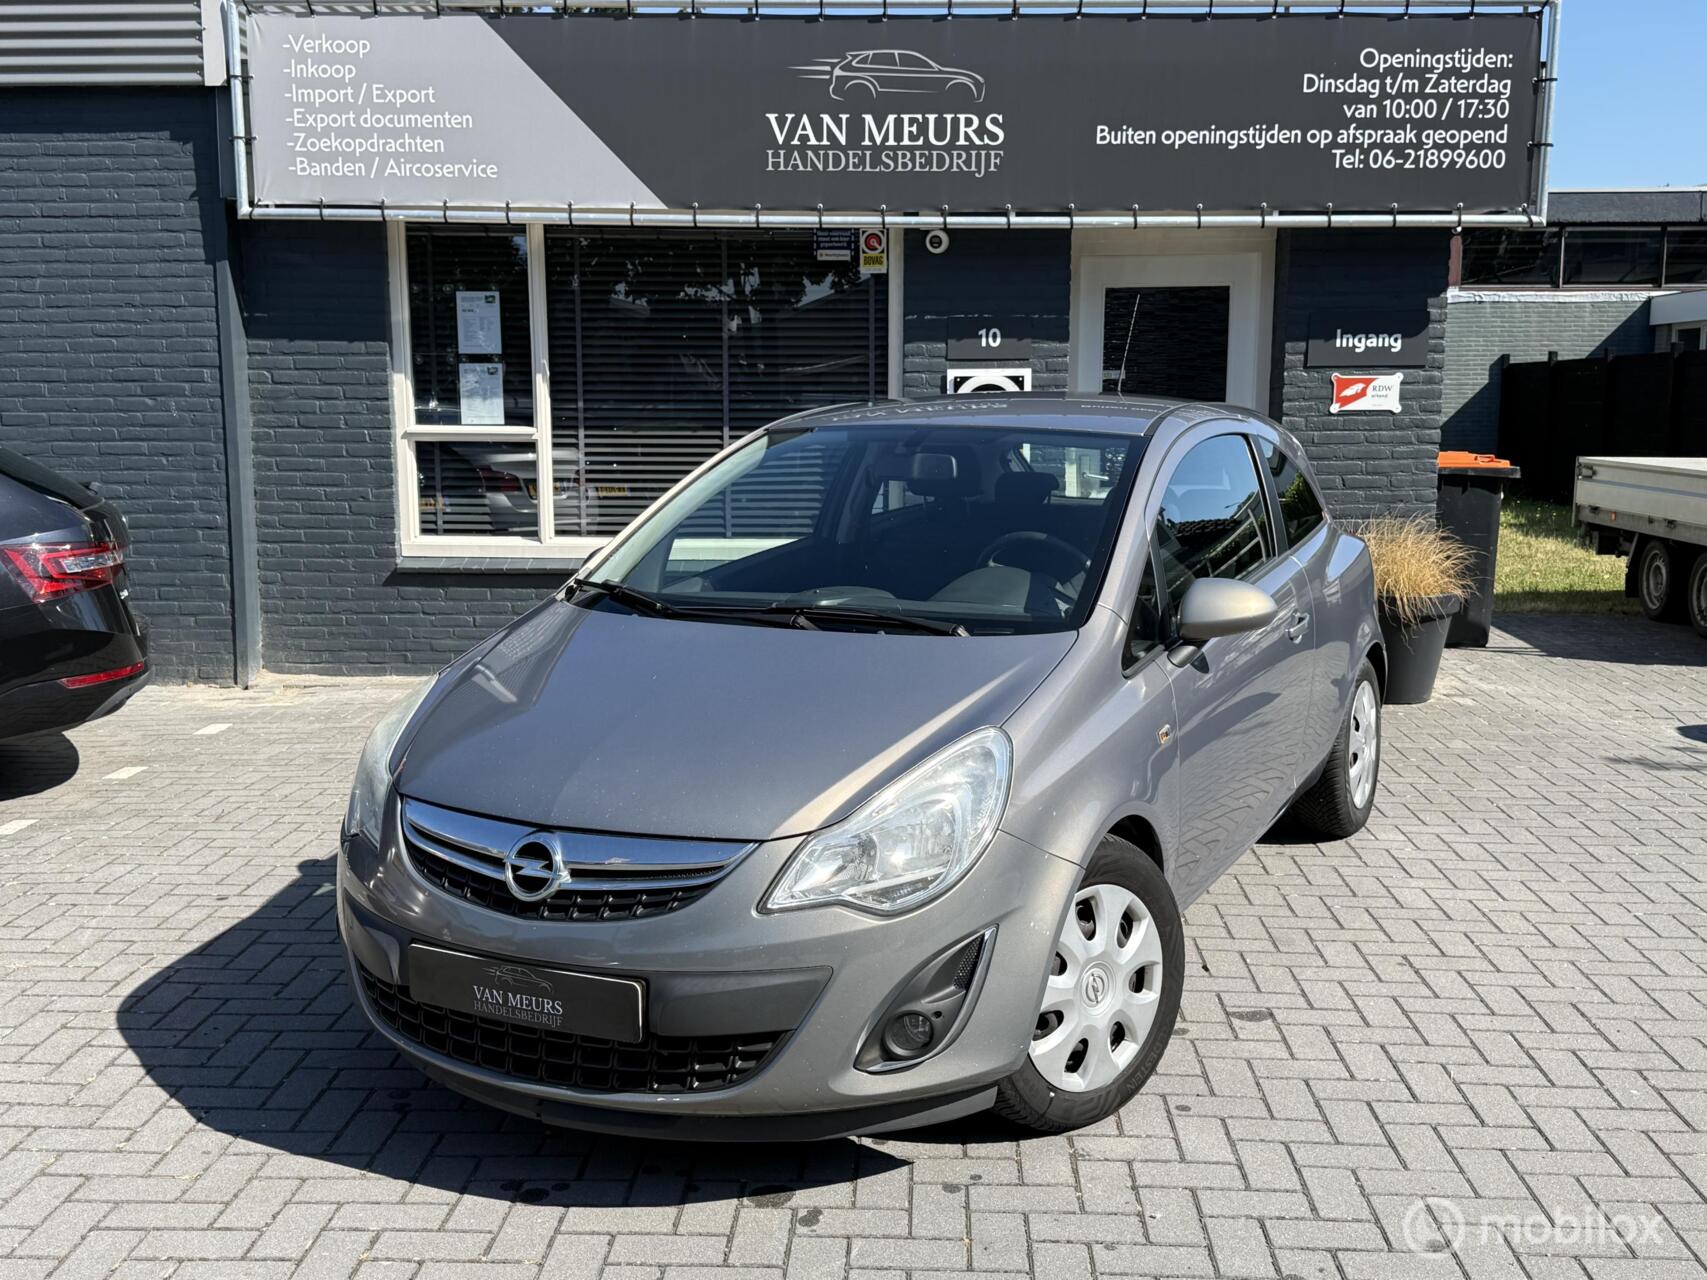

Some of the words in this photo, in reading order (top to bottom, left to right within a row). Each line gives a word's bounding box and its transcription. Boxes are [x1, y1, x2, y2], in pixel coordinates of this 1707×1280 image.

[282, 34, 371, 58] -Verkoop
[282, 58, 357, 82] -Inkoop
[1359, 47, 1514, 71] Openingstijden:
[284, 84, 355, 106] -Import
[357, 82, 368, 105] /
[372, 83, 436, 108] Export
[1302, 73, 1380, 98] Dinsdag
[1384, 72, 1419, 96] t/m
[1424, 73, 1512, 98] Zaterdag
[285, 108, 357, 131] -Export
[359, 107, 473, 129] documenten
[1343, 104, 1378, 119] van
[1382, 98, 1438, 119] 10:00
[1441, 97, 1454, 121] /
[1457, 96, 1510, 119] 17:30
[765, 113, 850, 146] VAN
[860, 113, 1005, 146] MEURS
[1096, 125, 1157, 145] Buiten
[1161, 123, 1302, 150] openingstijden
[1306, 129, 1333, 149] op
[1336, 123, 1417, 148] afspraak
[1421, 123, 1508, 149] geopend
[286, 133, 445, 156] -Zoekopdrachten
[288, 157, 366, 177] -Banden
[370, 156, 380, 179] /
[384, 157, 498, 178] Aircoservice
[765, 149, 1004, 178] HANDELSBEDRIJF
[1331, 148, 1365, 169] Tel:
[1369, 148, 1506, 169] 06-21899600
[863, 255, 885, 266] BOVAG
[978, 328, 1002, 347] 10
[1335, 329, 1402, 352] Ingang
[1371, 384, 1393, 392] RDW
[472, 985, 503, 1005] VAN
[507, 992, 563, 1015] MEURS
[473, 1001, 564, 1028] HANDELSBEDRIJF
